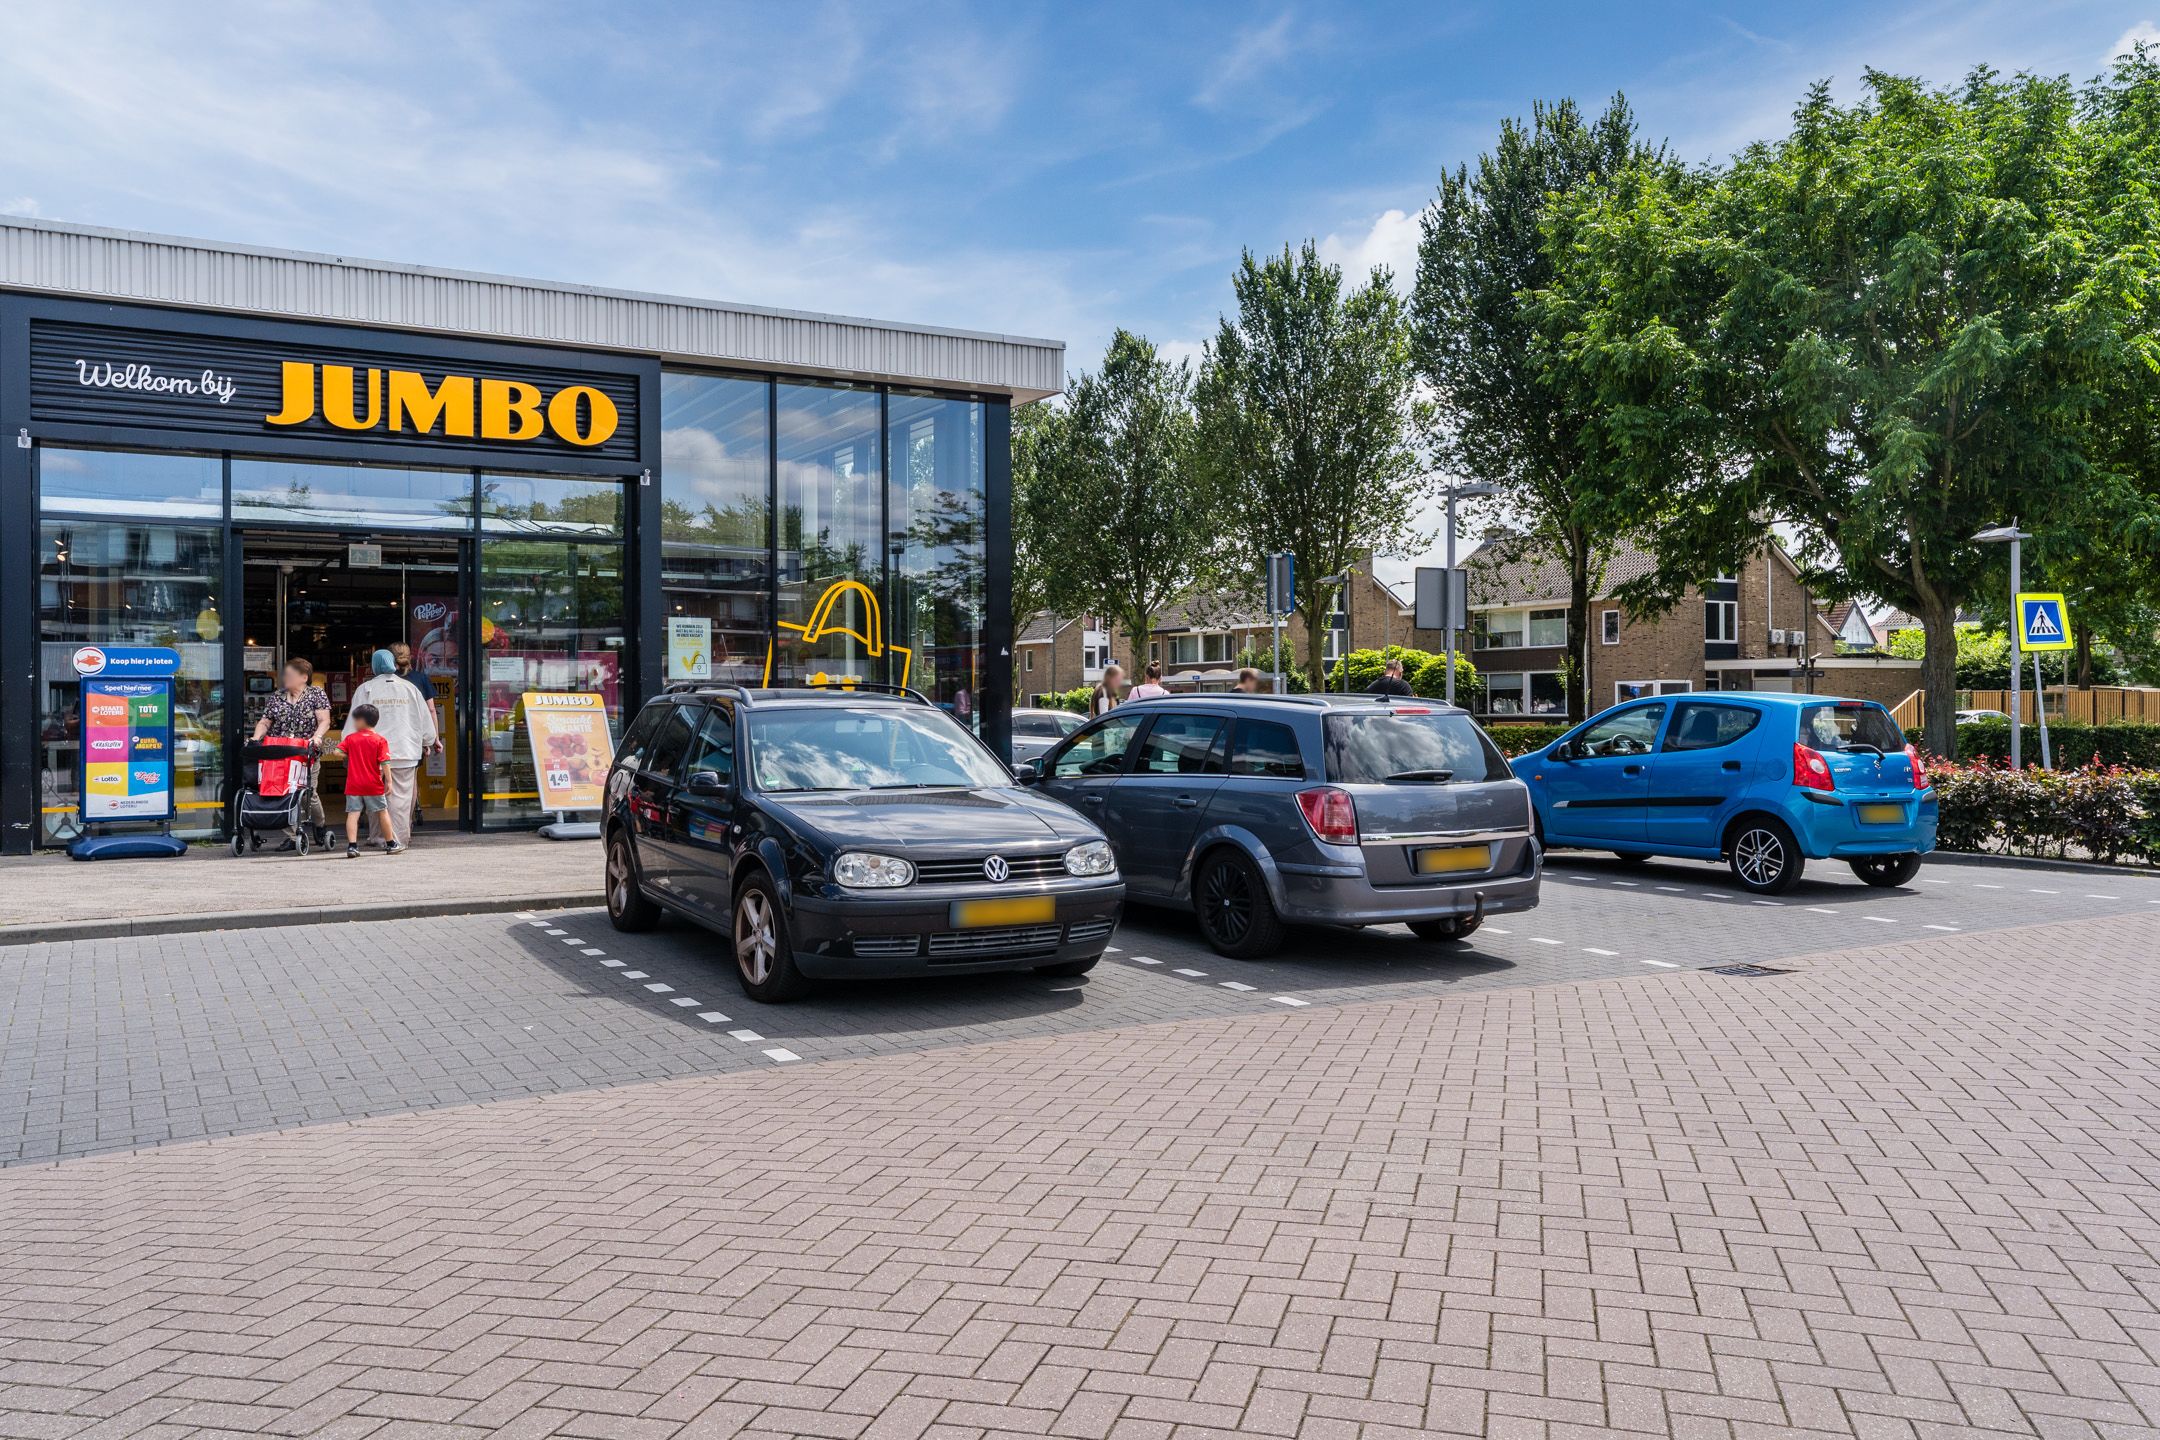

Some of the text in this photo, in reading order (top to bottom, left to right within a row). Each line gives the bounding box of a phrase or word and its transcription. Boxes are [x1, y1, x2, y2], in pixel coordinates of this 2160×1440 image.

[75, 359, 236, 404] Welkom bij
[265, 361, 619, 446] JUMBO
[417, 605, 443, 620] Pepper
[110, 657, 173, 666] Koop hier je loten
[123, 684, 137, 692] hier
[535, 695, 594, 706] JUMBO
[138, 705, 158, 714] TOTO
[549, 773, 569, 786] 4.49
